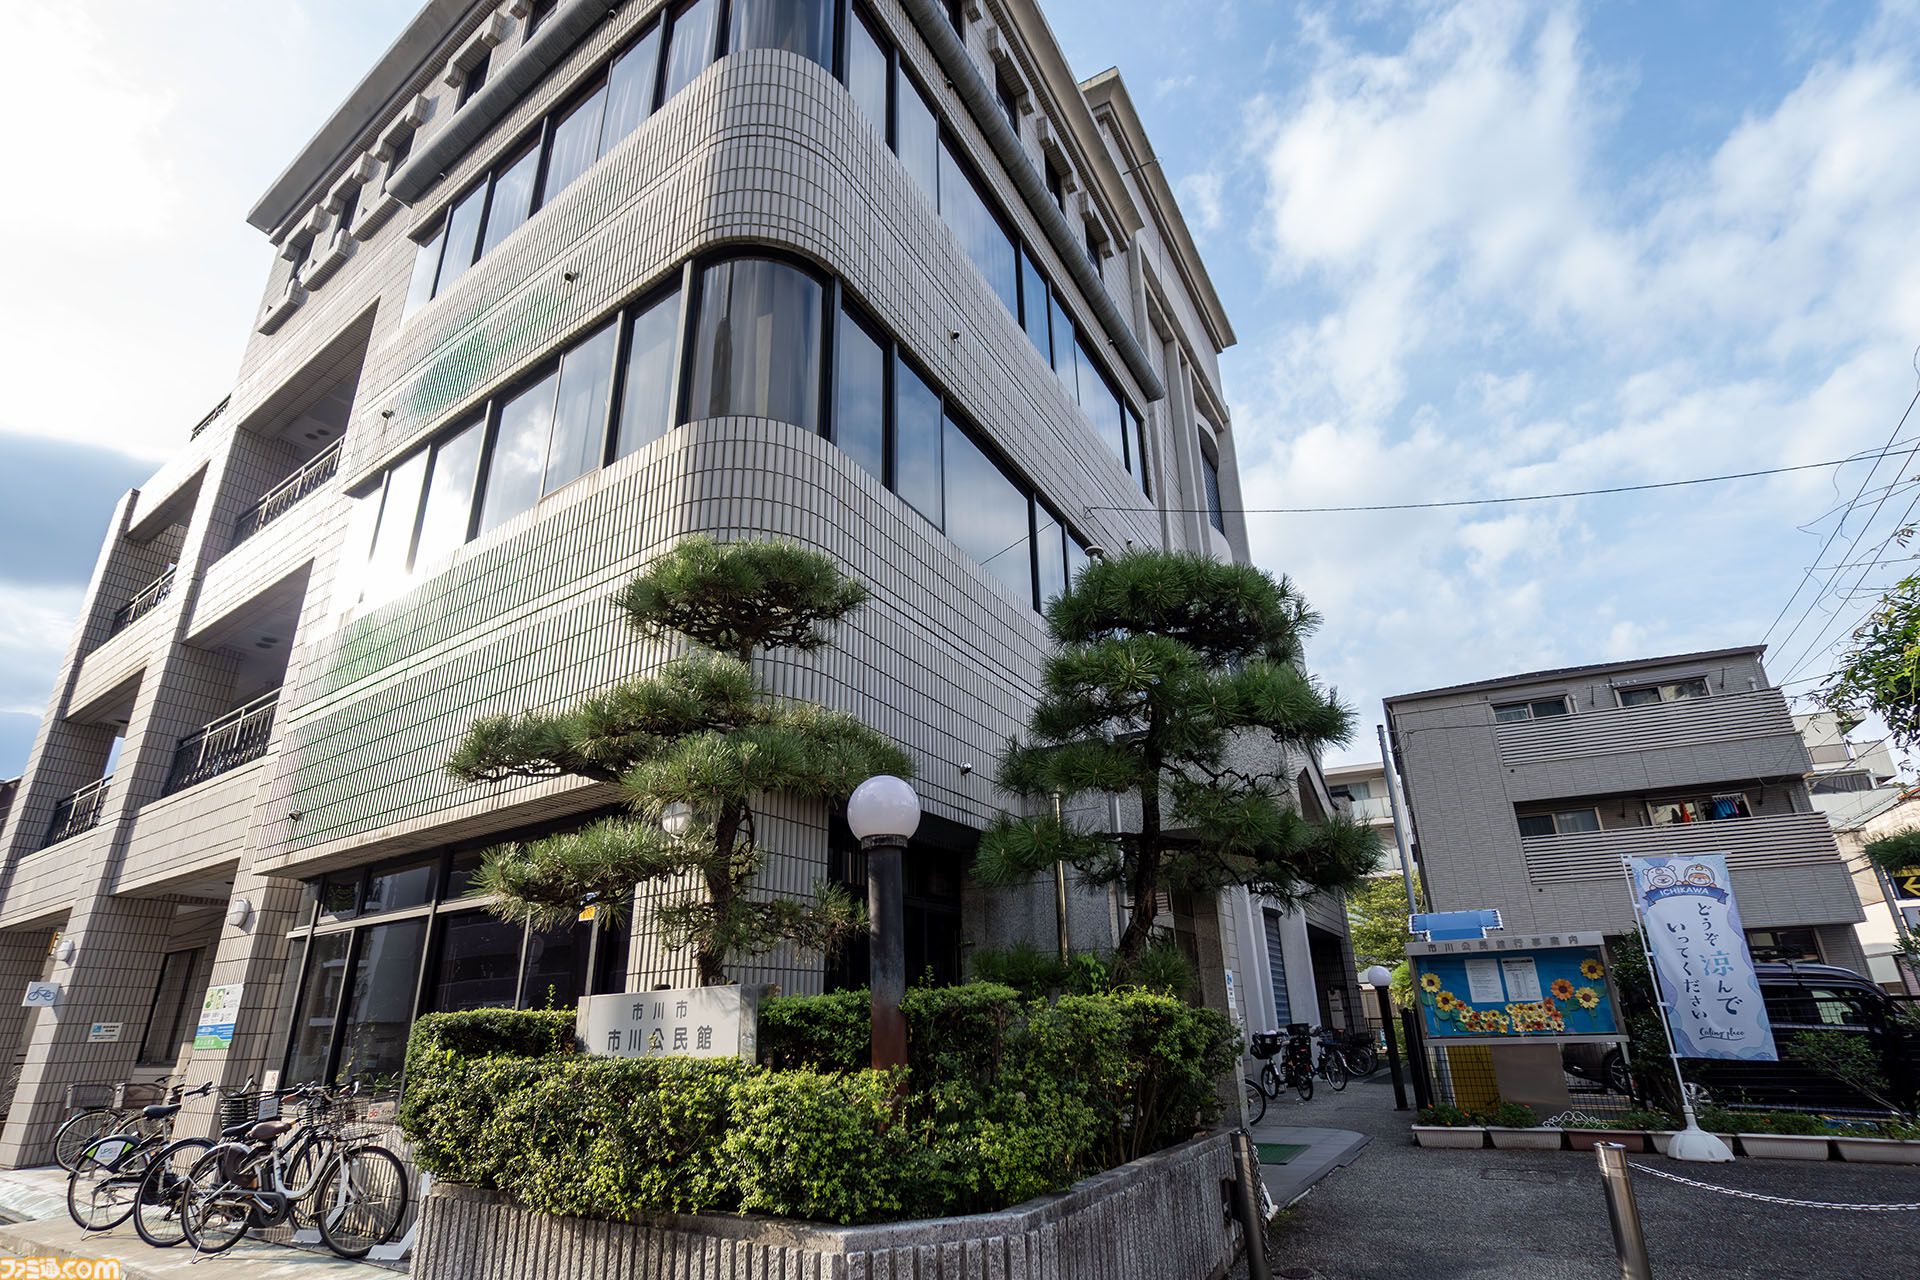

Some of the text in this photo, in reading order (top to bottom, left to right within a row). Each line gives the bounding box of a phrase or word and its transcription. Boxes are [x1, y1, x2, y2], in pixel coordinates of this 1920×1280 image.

[1659, 886, 1710, 897] ICHIKAWA
[1666, 922, 1708, 1020] いってください
[1697, 902, 1743, 1016] どうぞ涼んで
[632, 1000, 688, 1021] 市川市
[607, 1025, 712, 1052] 市川公民館
